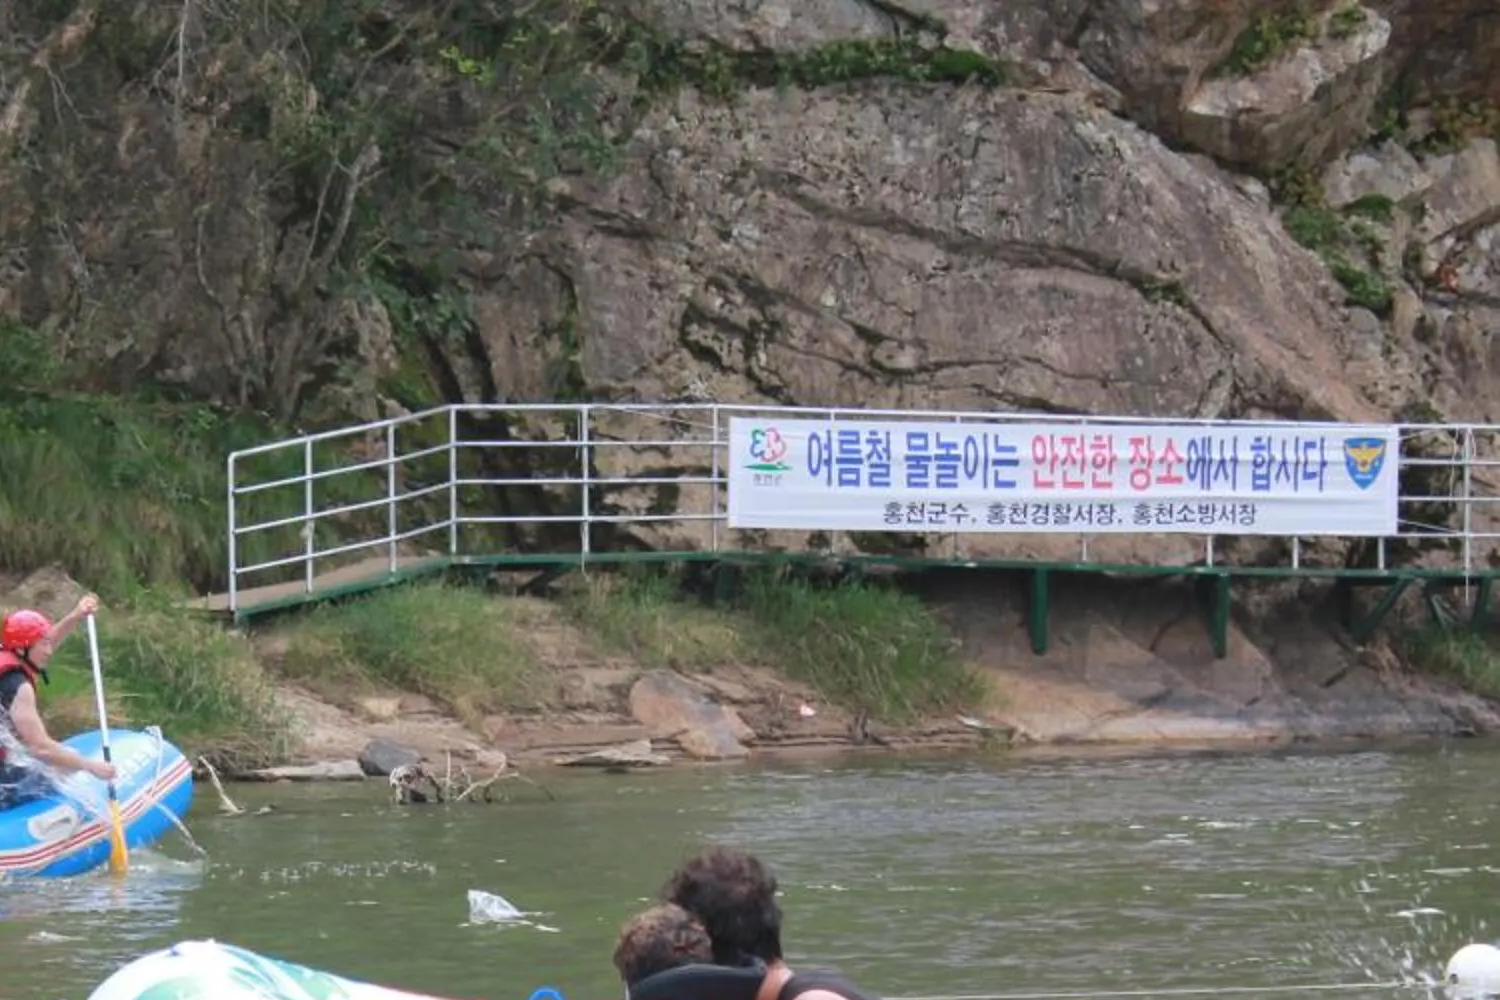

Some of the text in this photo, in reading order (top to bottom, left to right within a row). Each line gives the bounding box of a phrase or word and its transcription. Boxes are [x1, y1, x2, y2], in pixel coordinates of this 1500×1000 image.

[807, 429, 1328, 492] 여름철 물놀이는 안전한 장소에서 합시다
[1133, 502, 1257, 526] 홍천소방서장
